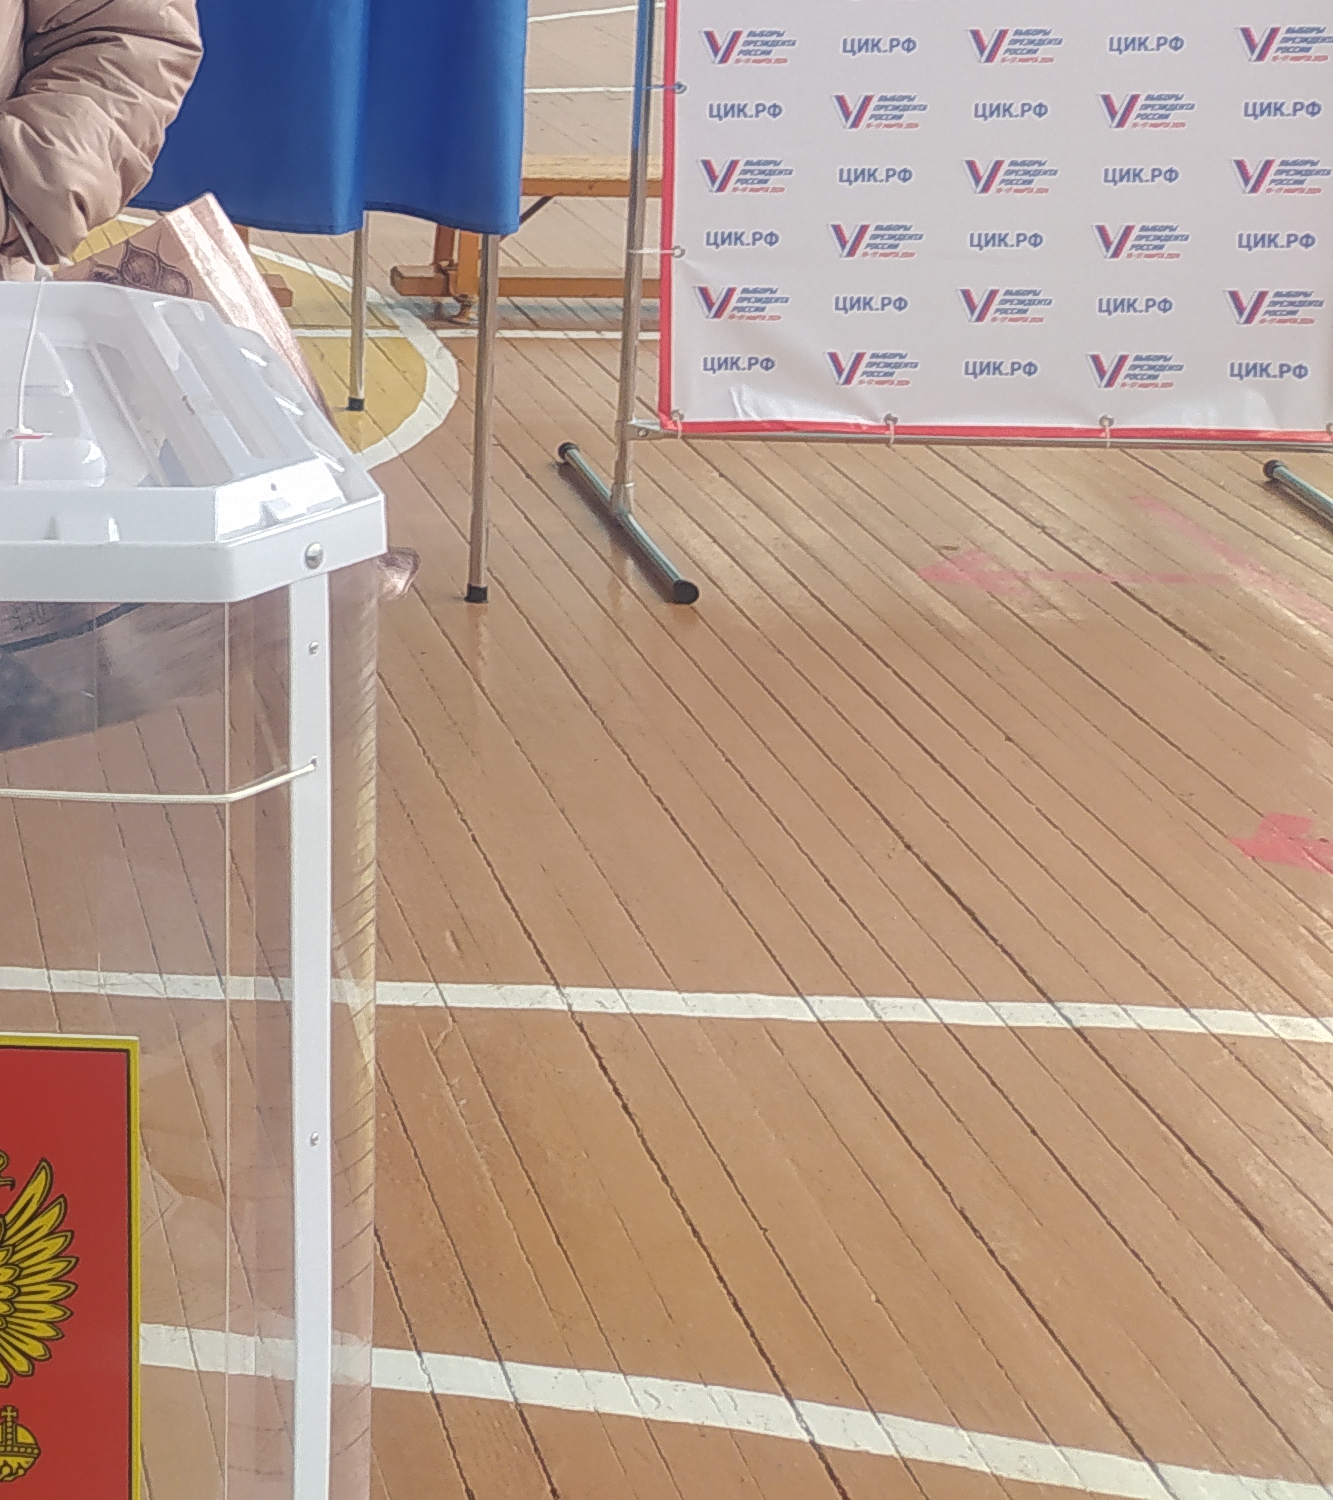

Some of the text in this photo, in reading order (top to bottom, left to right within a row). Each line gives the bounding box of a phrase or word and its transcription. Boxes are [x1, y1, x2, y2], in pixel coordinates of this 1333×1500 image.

[841, 37, 917, 57] ЦИК.РФ
[1108, 35, 1185, 56] ЦИК.РФ
[708, 102, 783, 122] ЦИК.РФ
[973, 101, 1049, 122] ЦИК.РФ
[1243, 100, 1322, 121] ЦИК.РФ
[838, 167, 913, 187] ЦИК.РФ
[1103, 166, 1180, 187] ЦИК.РФ
[705, 230, 780, 250] ЦИК.РФ
[969, 232, 1044, 252] ЦИК.РФ
[1237, 232, 1316, 252] ЦИК.РФ
[834, 295, 909, 315] ЦИК.РФ
[1097, 297, 1173, 317] ЦИК.РФ
[702, 356, 776, 375] ЦИК.РФ
[964, 360, 1039, 380] ЦИК.РФ
[1229, 361, 1309, 381] ЦИК.РФ
